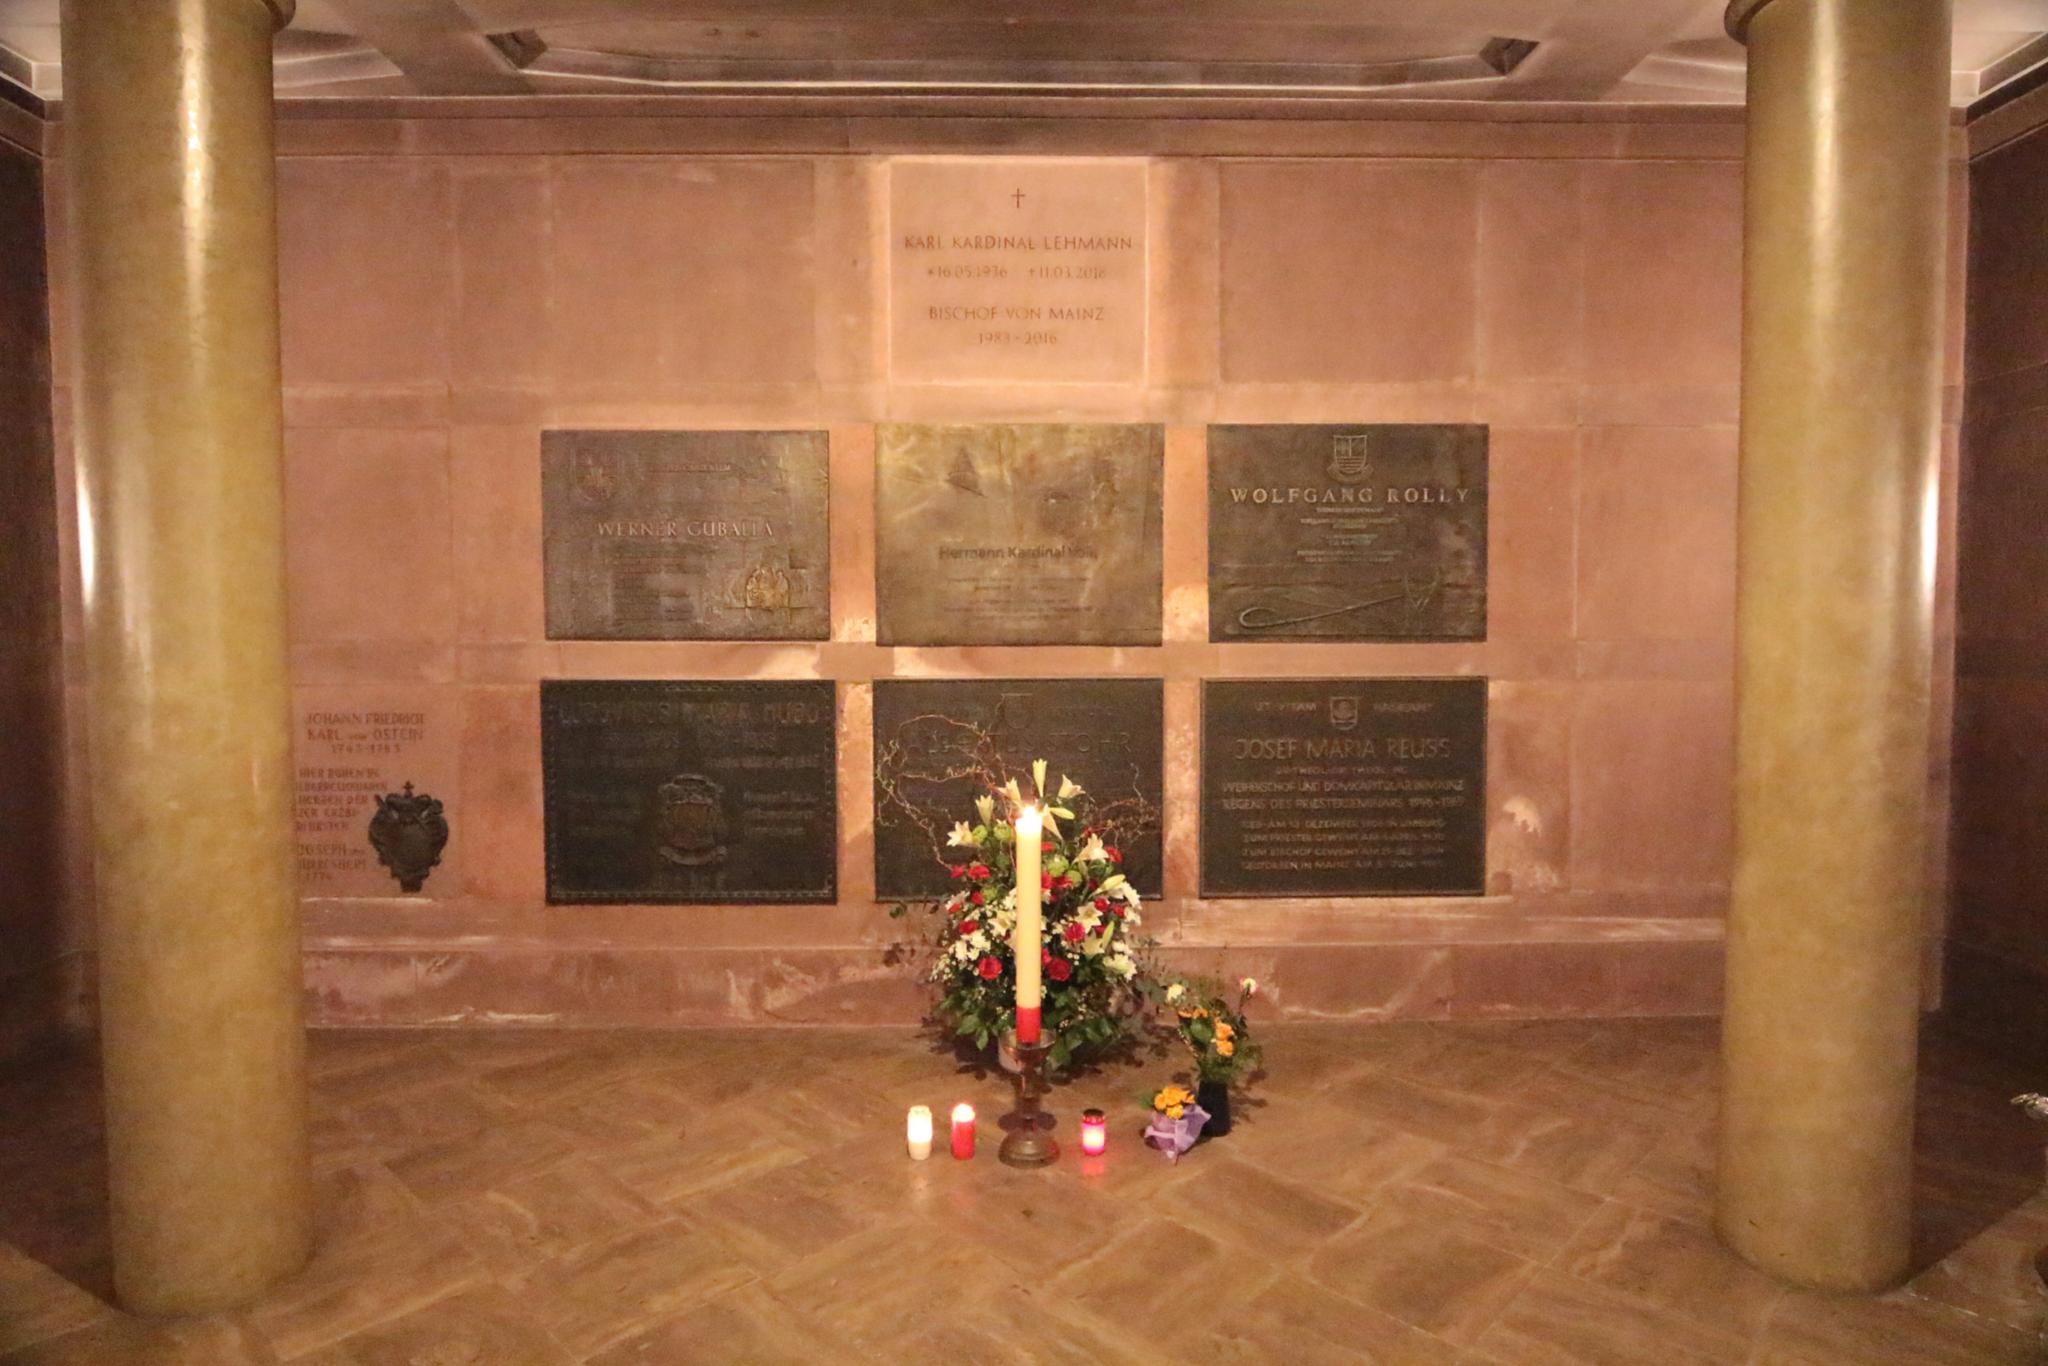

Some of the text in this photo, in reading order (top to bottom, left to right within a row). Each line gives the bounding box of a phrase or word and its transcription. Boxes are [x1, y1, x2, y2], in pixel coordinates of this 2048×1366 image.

[903, 235, 1133, 250] KARL KARDINAL LEHMANN
[928, 306, 1106, 321] BISCHOF VON MAINZ
[1229, 487, 1471, 503] WOLFGANG ROLLY
[597, 520, 775, 537] WERNER GUBALLA
[938, 545, 1005, 560] Hermann
[1007, 544, 1066, 560] Kardinal
[304, 712, 425, 725] JOHANN FRIEDRICH
[307, 728, 344, 741] KARL
[372, 728, 425, 741] OSTEIN
[1234, 738, 1451, 760] JOSEF MARIA REUSS
